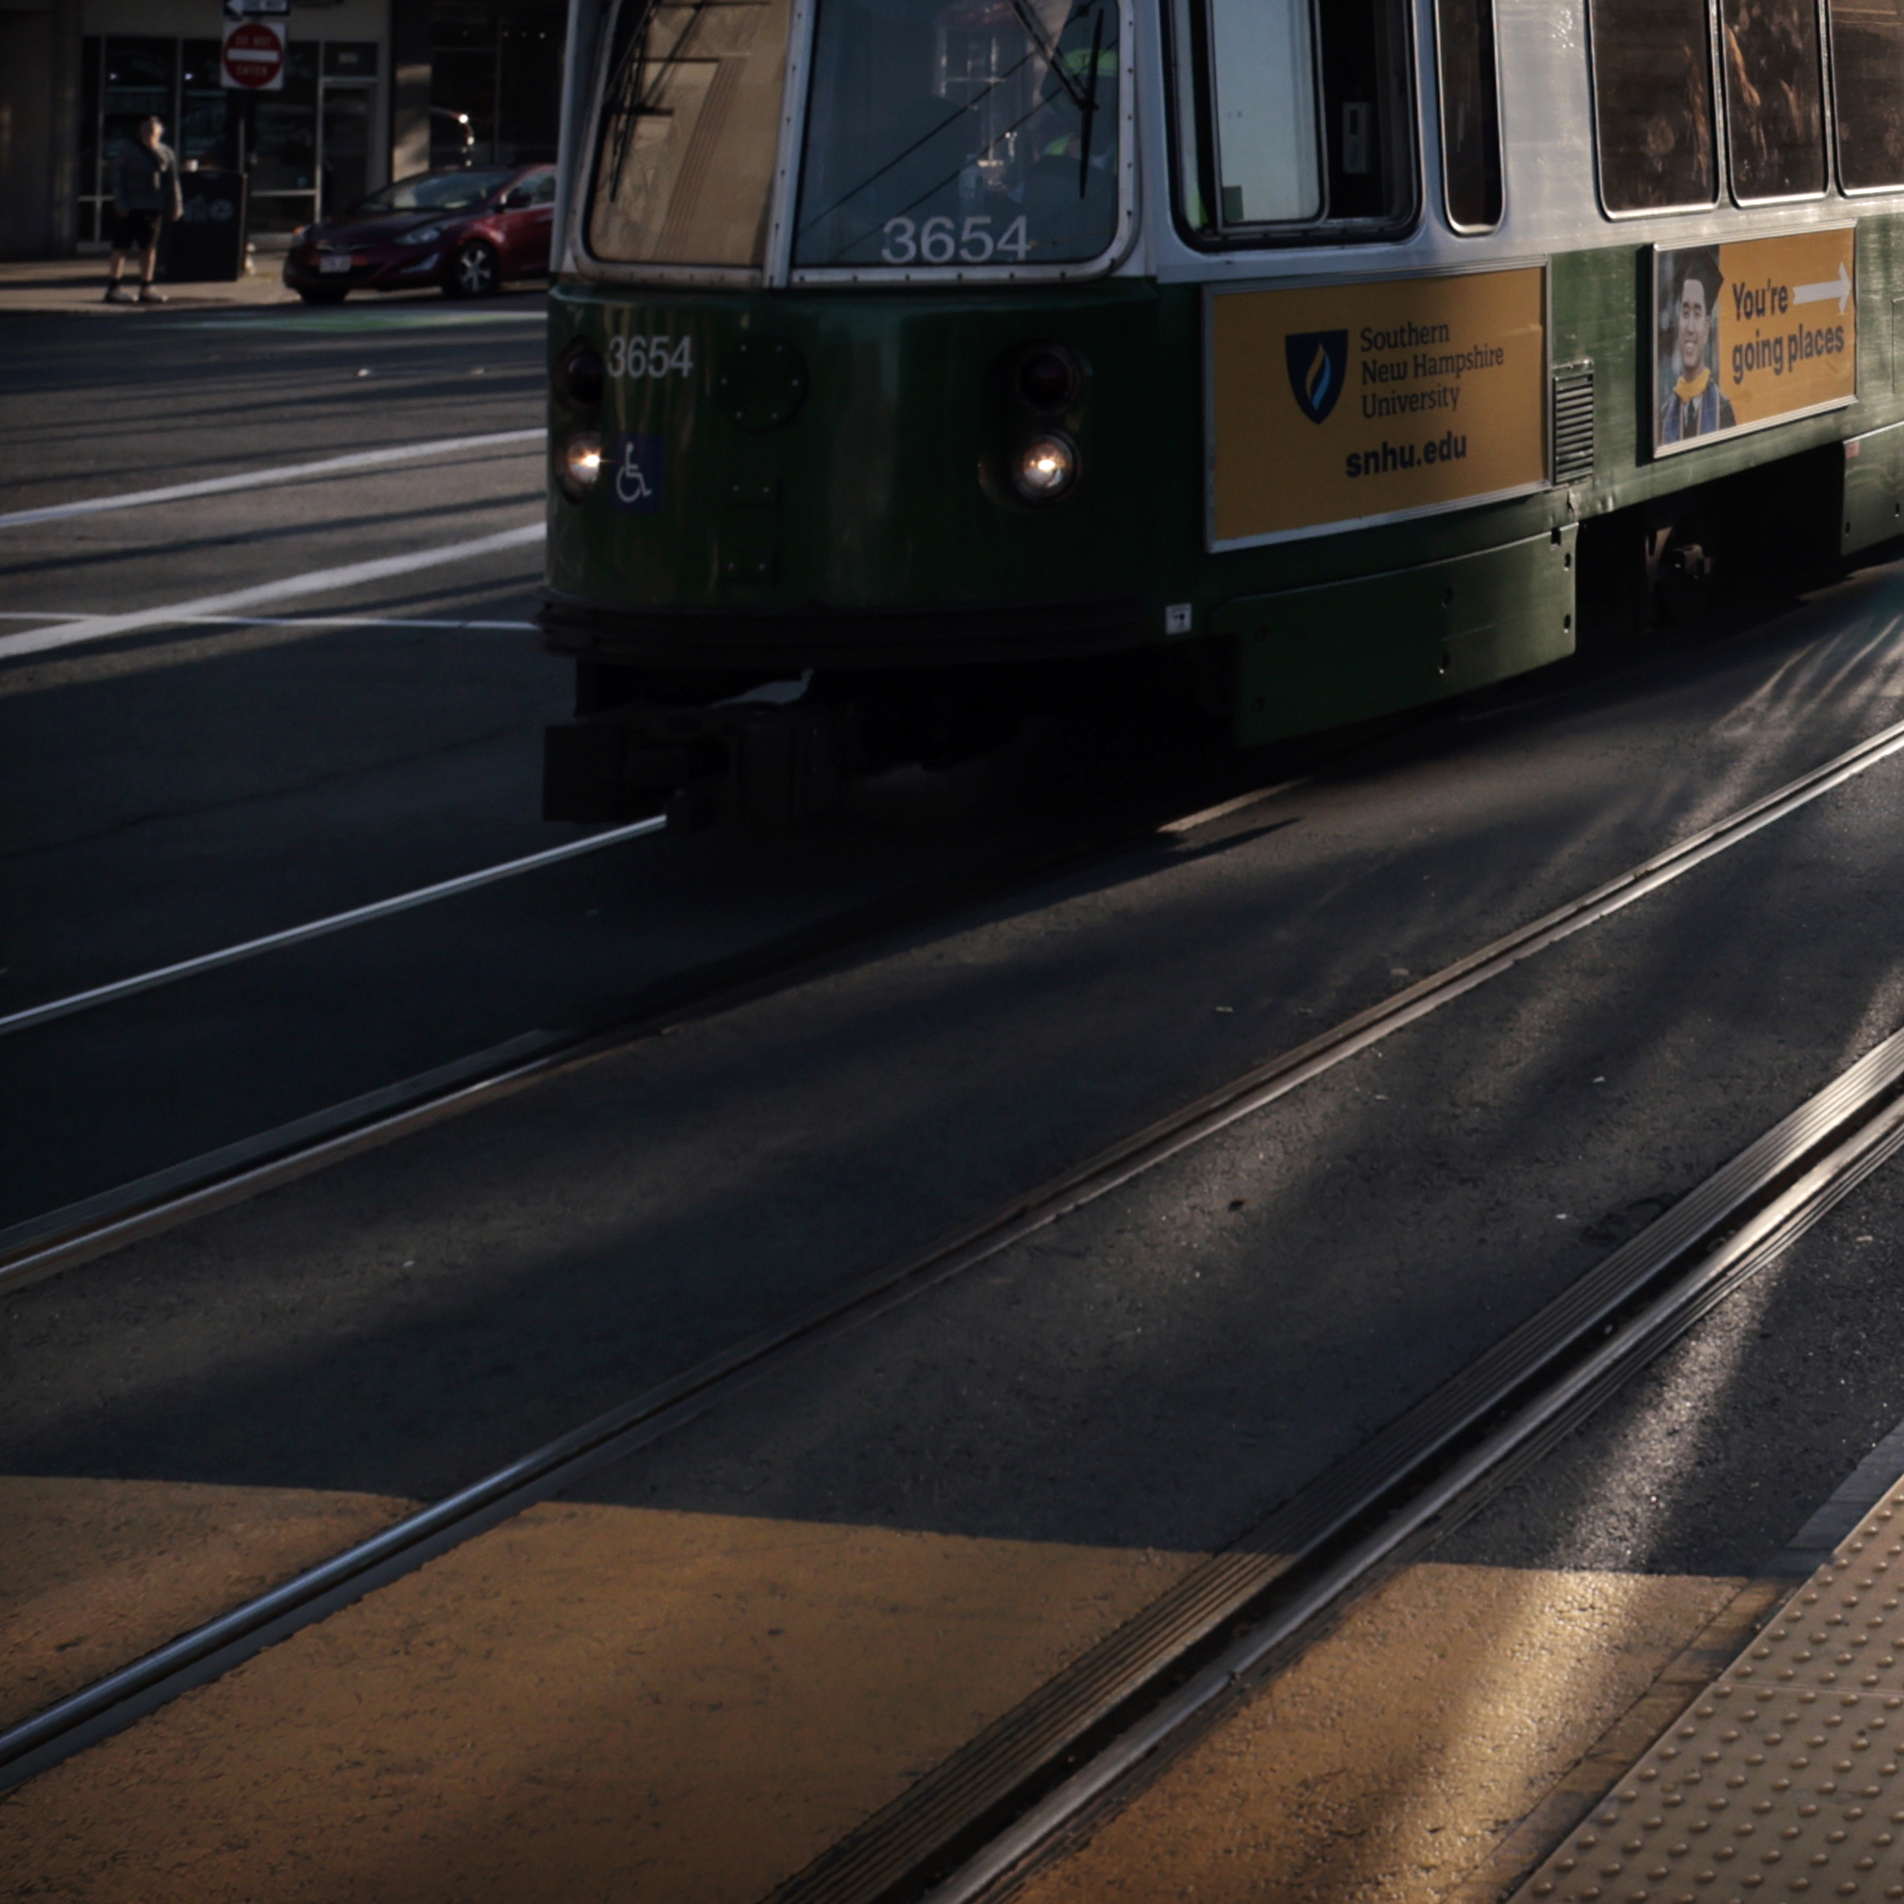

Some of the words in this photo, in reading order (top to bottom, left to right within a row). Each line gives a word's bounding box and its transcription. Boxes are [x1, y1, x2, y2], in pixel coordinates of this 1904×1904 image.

[881, 214, 1033, 264] 3654
[1732, 277, 1788, 322] You're
[607, 334, 694, 380] 3654
[1360, 321, 1450, 353] Southern
[1732, 328, 1784, 385] going
[1788, 323, 1844, 373] places
[1361, 359, 1408, 385] New
[1413, 343, 1504, 379] Hampshire
[1362, 383, 1460, 419] University
[1345, 430, 1467, 478] snhu.edu
